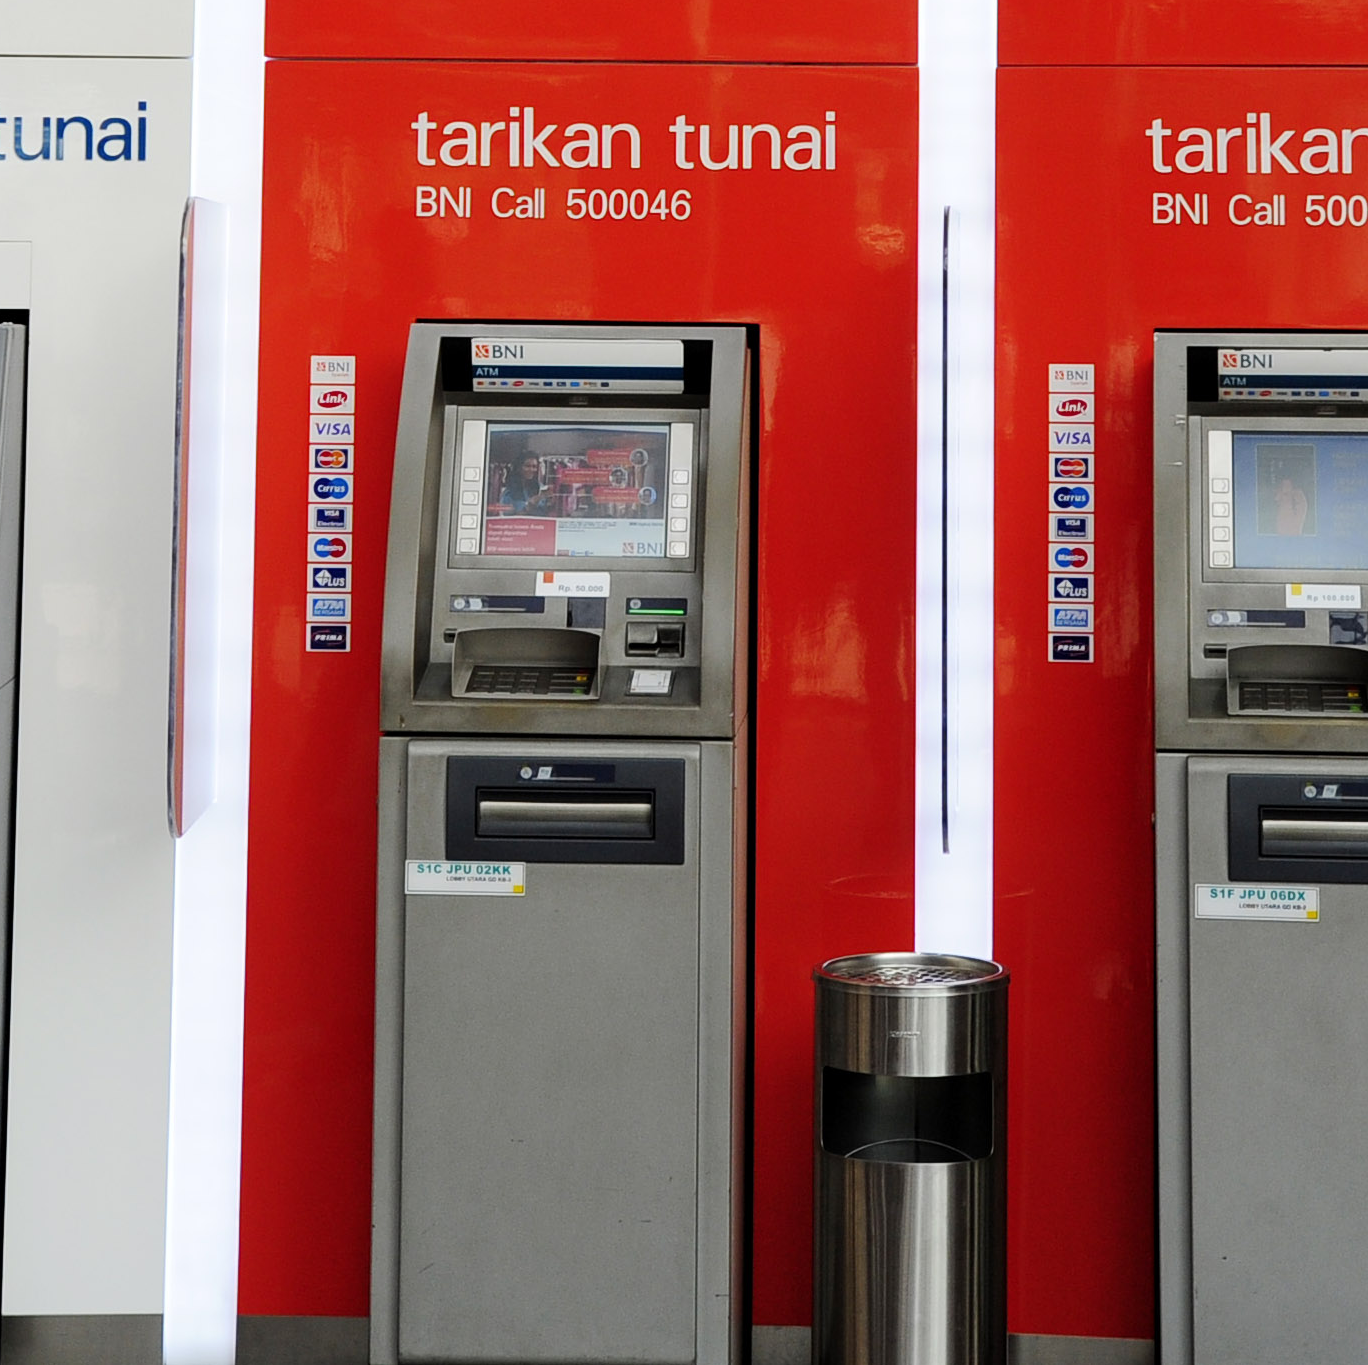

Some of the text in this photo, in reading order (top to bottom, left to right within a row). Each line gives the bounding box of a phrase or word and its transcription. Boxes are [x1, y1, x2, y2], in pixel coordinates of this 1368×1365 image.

[411, 107, 835, 170] tarikan tunai
[416, 186, 691, 220] BNI Call 500046
[1153, 193, 1208, 225] BNI
[1229, 194, 1285, 225] Call
[493, 345, 524, 358] BNI
[1241, 354, 1272, 368] BNI
[329, 362, 349, 372] BNI
[476, 368, 499, 376] ATM
[1067, 371, 1088, 380] BNI
[1223, 377, 1246, 385] ATM
[319, 393, 346, 405] Link
[1058, 401, 1086, 414] Link
[315, 423, 351, 435] VISA
[1054, 432, 1091, 444] VISA
[317, 484, 345, 493] Cirrus
[1058, 494, 1086, 502] Cirrus
[637, 543, 662, 554] BNI
[417, 864, 511, 875] S1C JPU 02KK
[1210, 889, 1305, 900] S1F JPU 06DX
